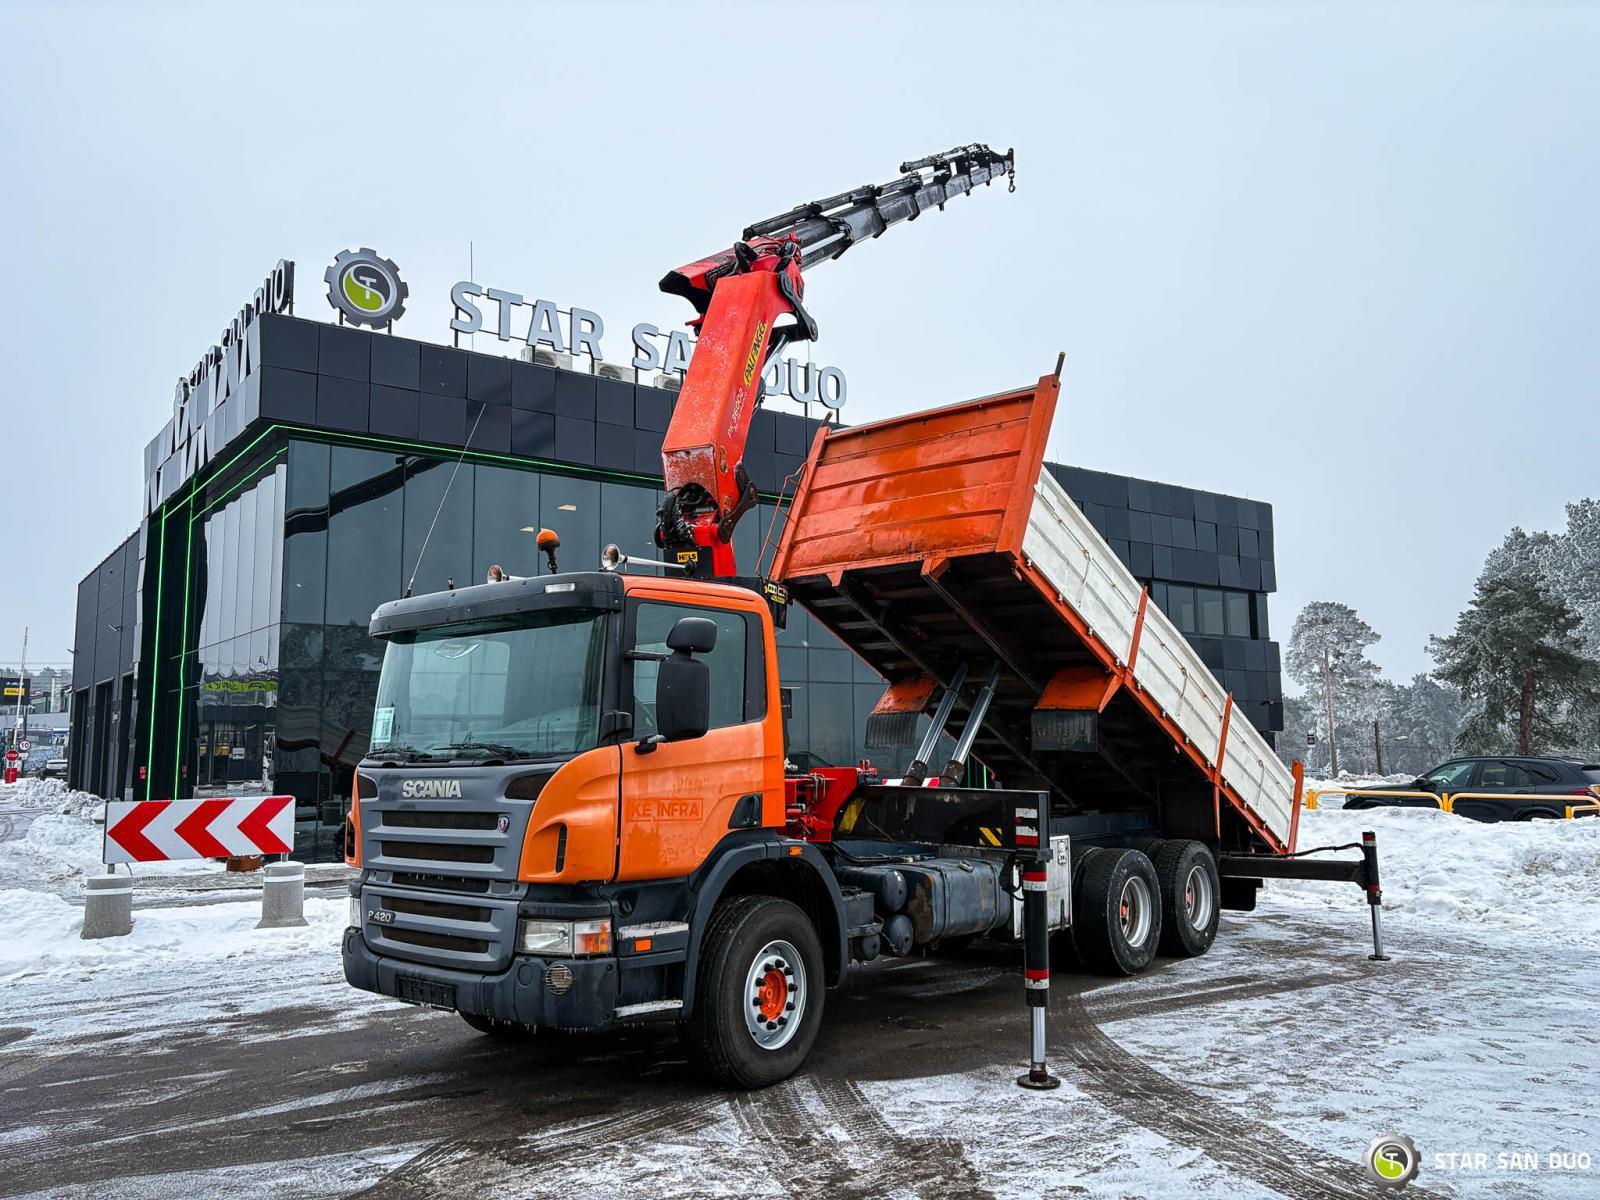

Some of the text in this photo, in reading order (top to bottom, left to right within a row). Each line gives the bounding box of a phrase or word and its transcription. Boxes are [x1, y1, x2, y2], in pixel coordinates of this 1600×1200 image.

[450, 281, 604, 361] STAR
[632, 322, 692, 375] SA
[402, 780, 462, 798] SCANIA
[656, 802, 699, 817] INFRA
